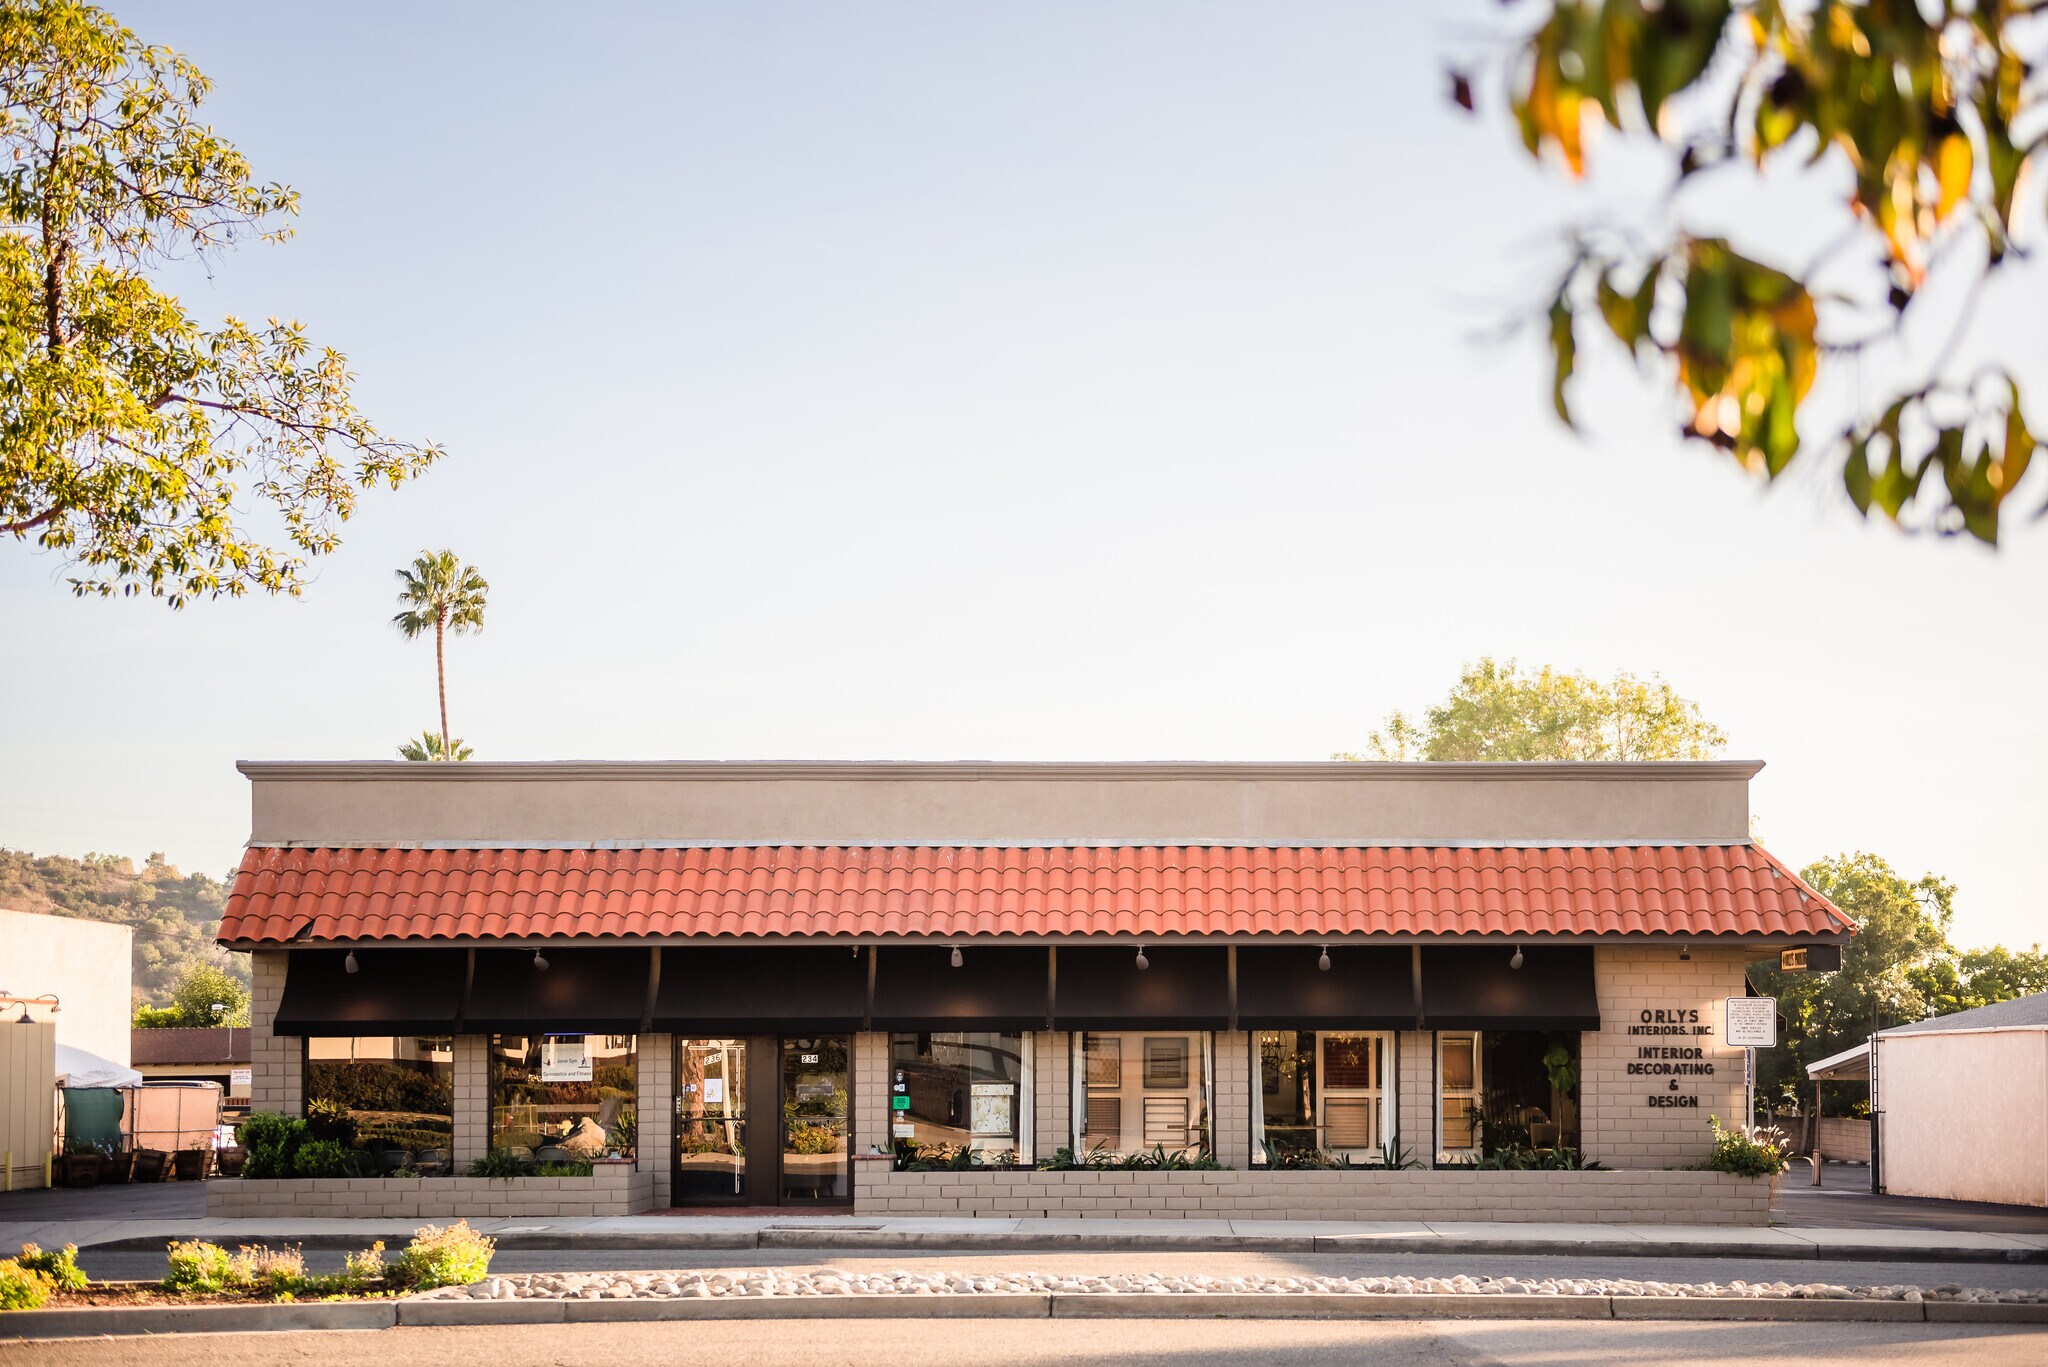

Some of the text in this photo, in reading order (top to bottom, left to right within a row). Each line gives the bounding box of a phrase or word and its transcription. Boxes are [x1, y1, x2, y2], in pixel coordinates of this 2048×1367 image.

[1640, 1009, 1699, 1024] ORLYS
[1692, 1025, 1715, 1036] INC.
[704, 1053, 721, 1065] 236
[802, 1055, 818, 1063] 234
[1638, 1046, 1704, 1060] INTERIOR
[1627, 1062, 1715, 1076] DECORATING
[1668, 1079, 1679, 1091] &
[1647, 1095, 1699, 1108] DESIGN
